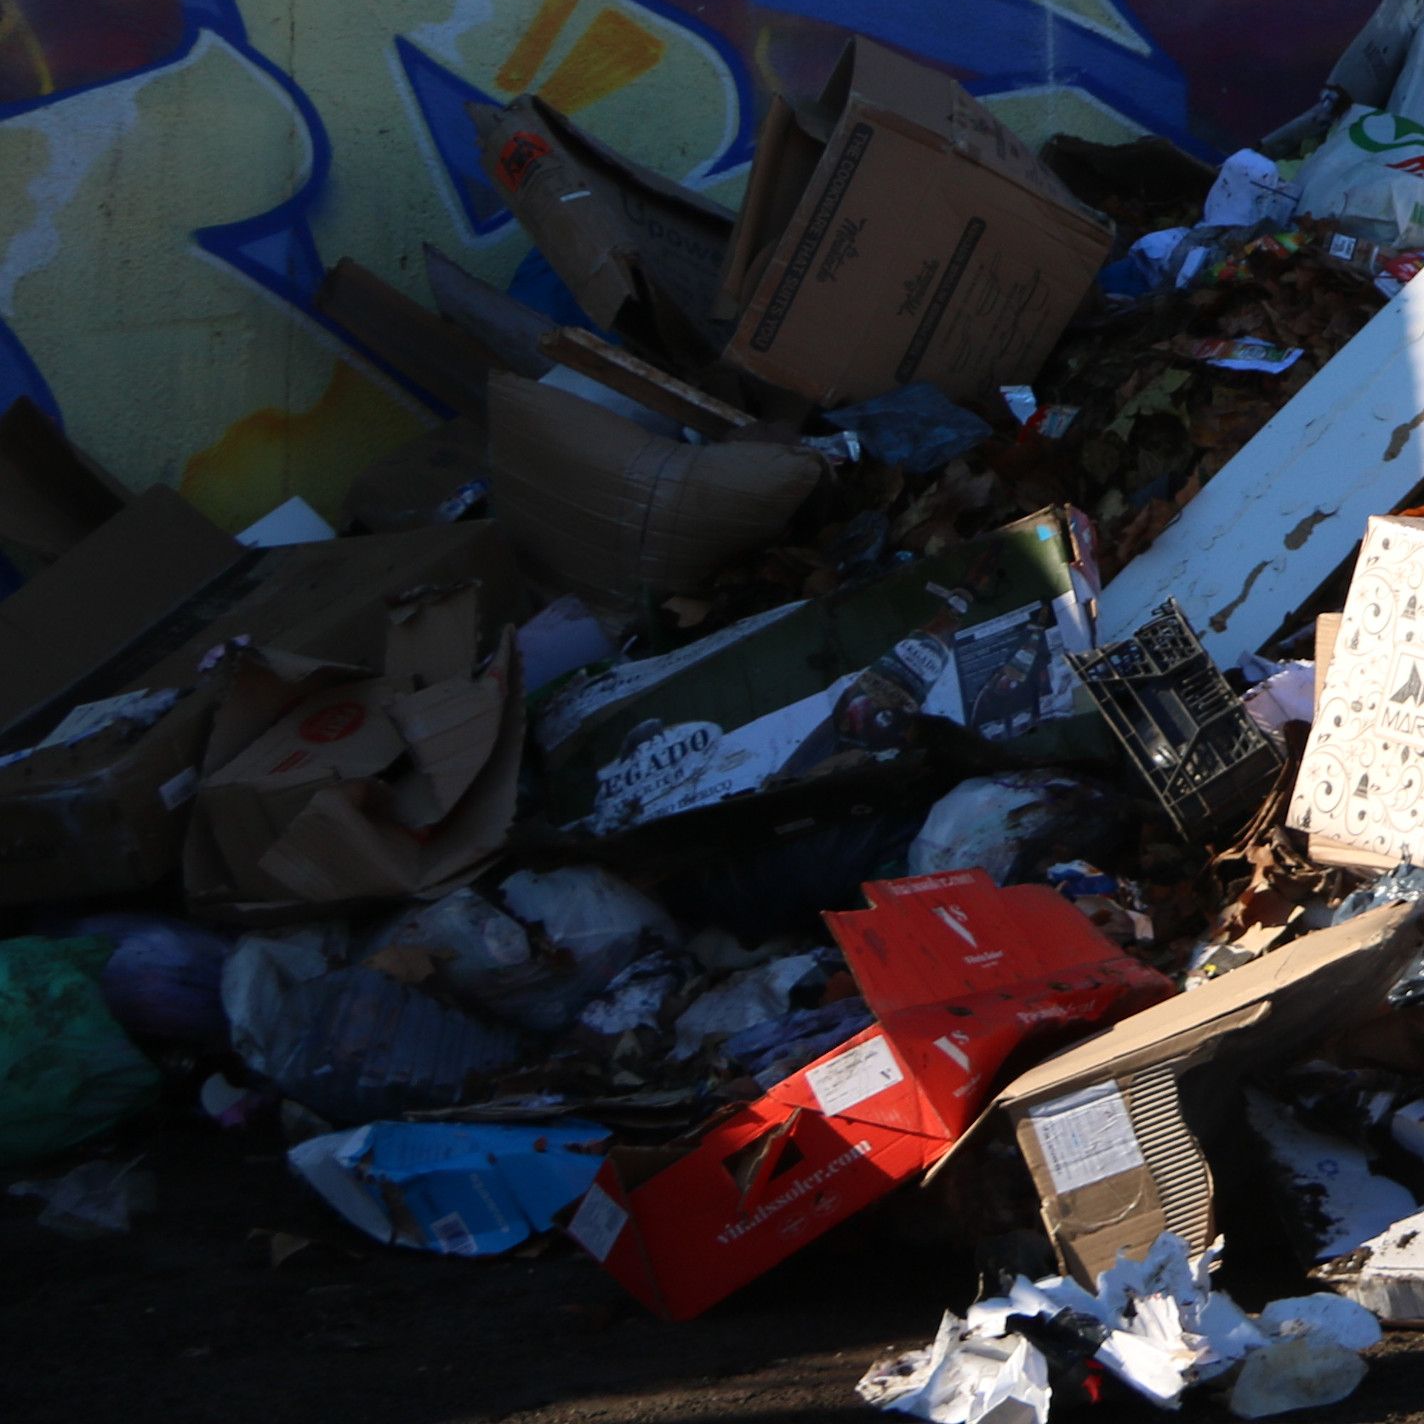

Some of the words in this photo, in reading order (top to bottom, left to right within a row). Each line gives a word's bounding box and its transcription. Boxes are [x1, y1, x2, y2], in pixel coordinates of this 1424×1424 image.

[847, 129, 872, 162] THE
[807, 159, 859, 242] COOKWARE
[788, 235, 819, 278] THAT
[767, 272, 799, 318] SUITS
[752, 314, 779, 349] YOU
